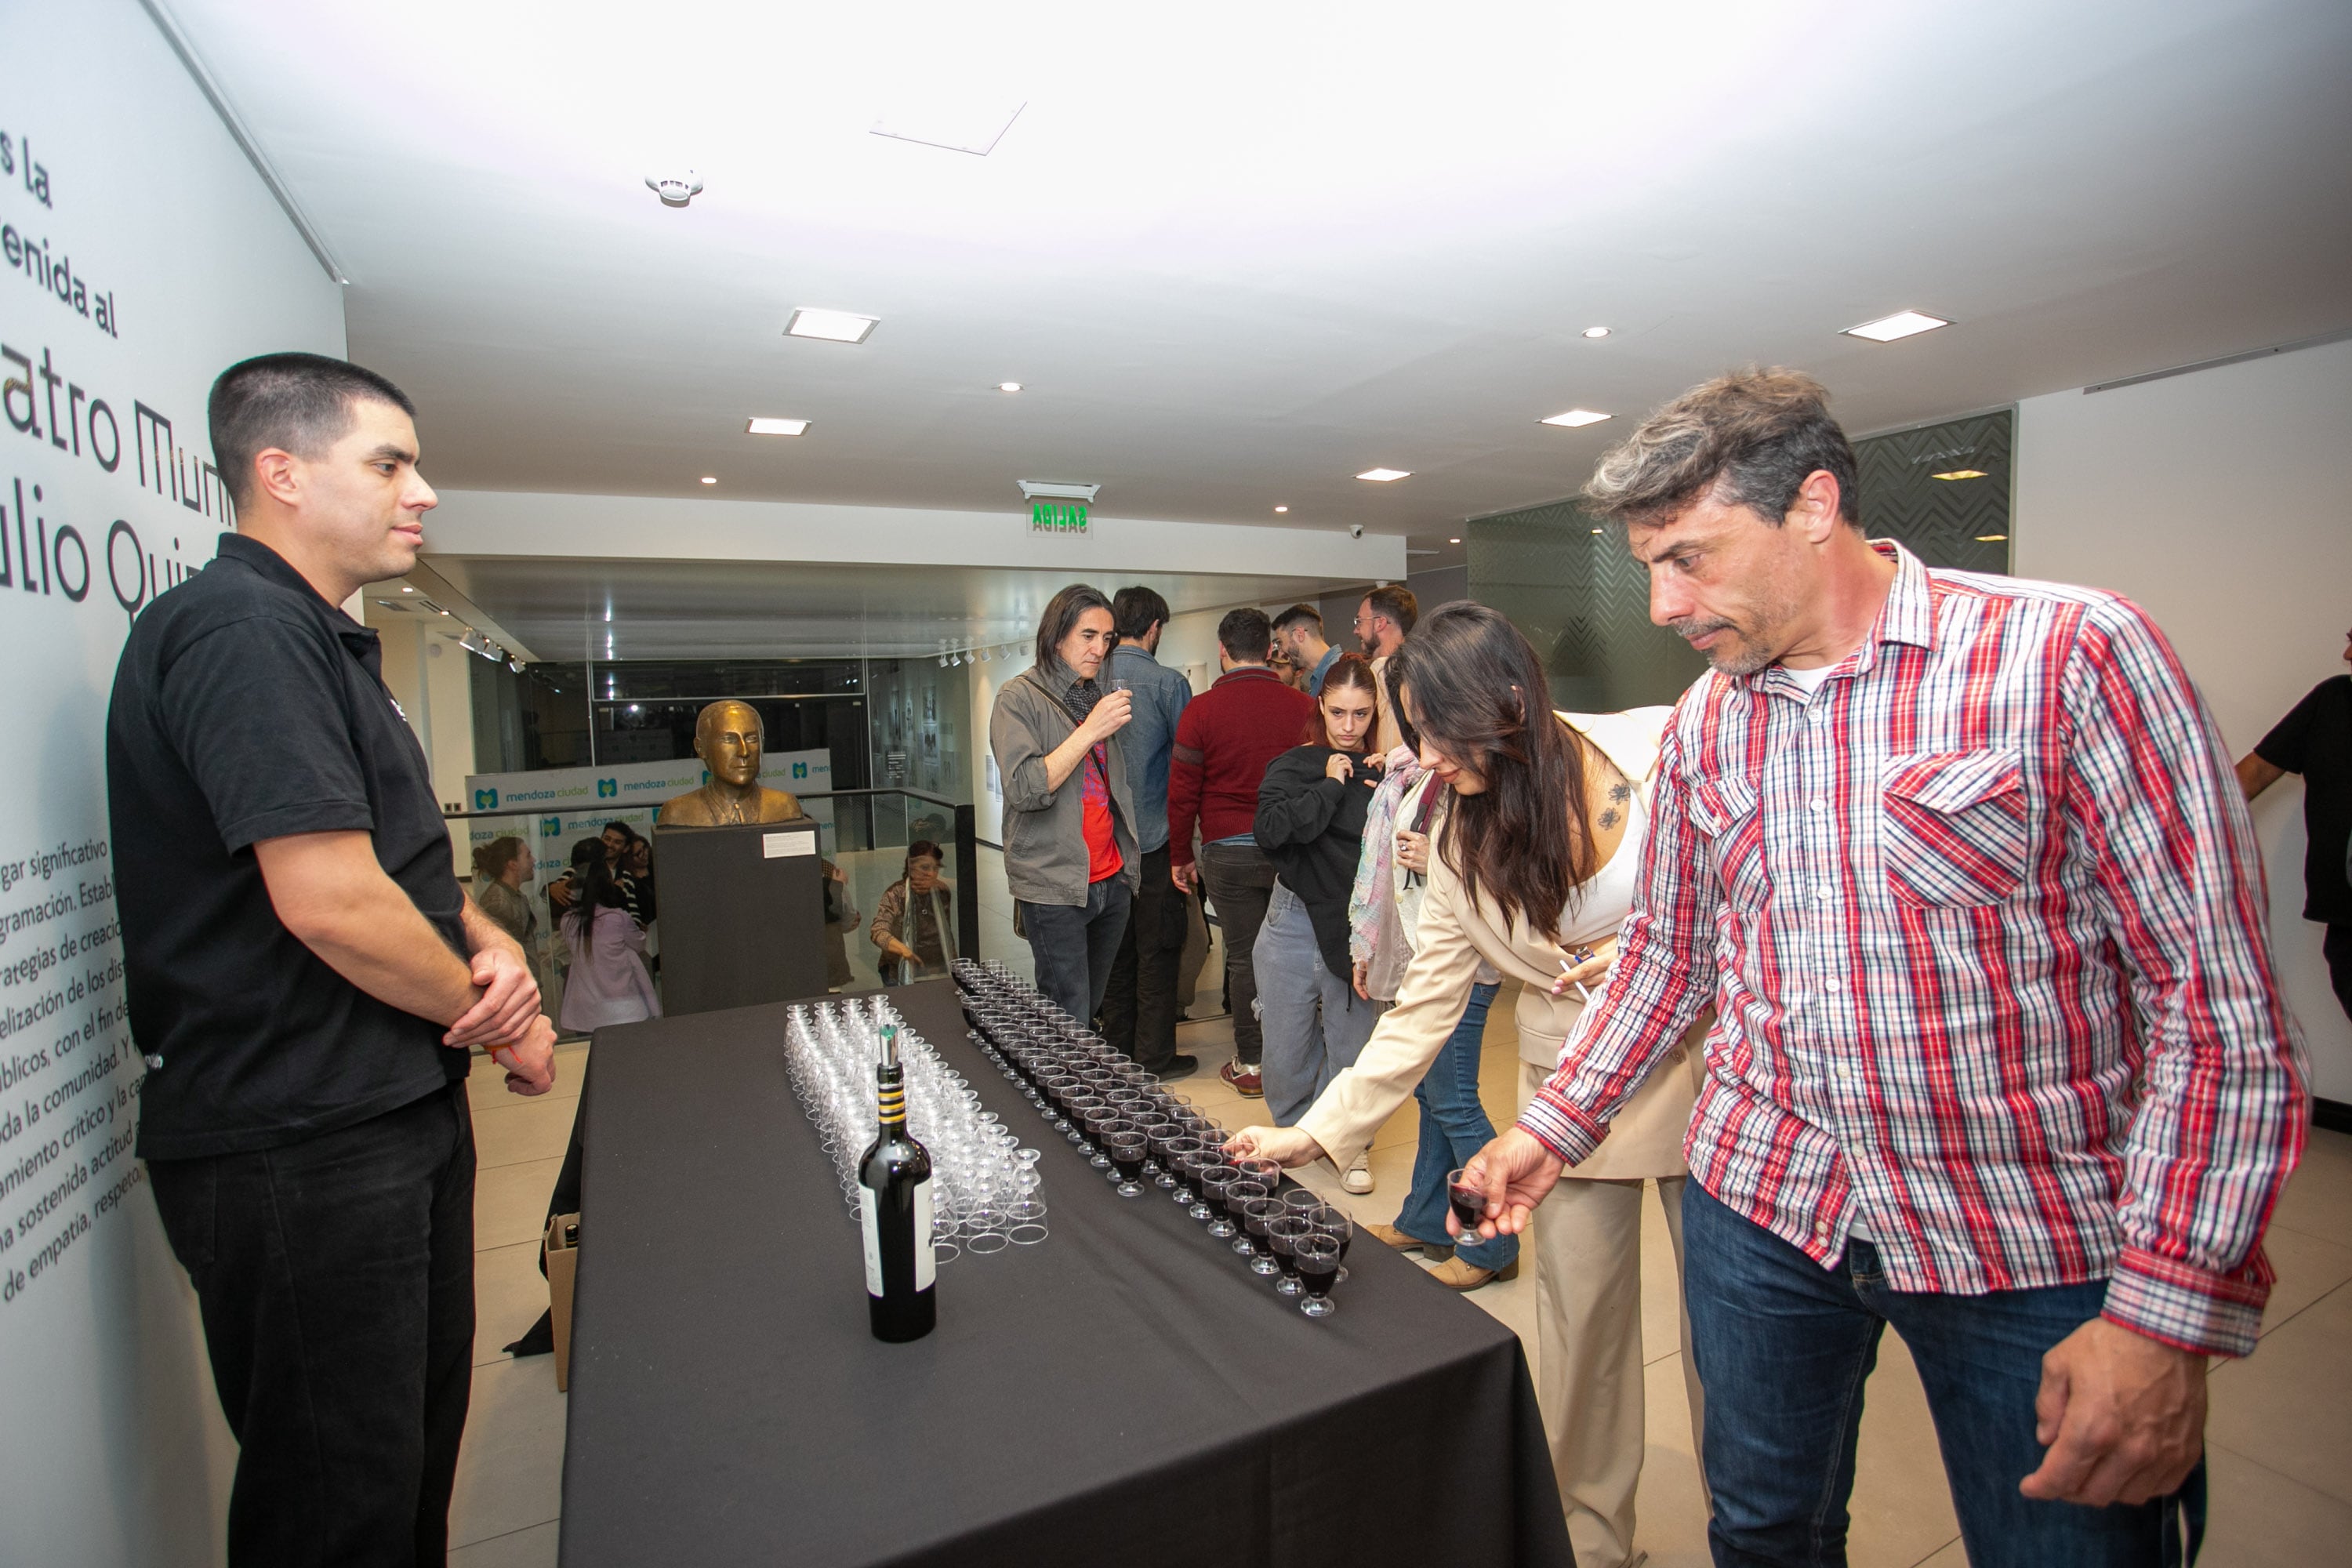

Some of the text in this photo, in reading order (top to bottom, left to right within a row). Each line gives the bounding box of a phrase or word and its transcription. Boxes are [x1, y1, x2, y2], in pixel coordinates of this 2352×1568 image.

[22, 136, 53, 210] la
[95, 289, 118, 339] al
[107, 518, 202, 626] Qui
[506, 786, 589, 803] mendoza ciudad
[624, 776, 694, 791] mendoza ciudad
[762, 768, 786, 779] ciudad
[30, 838, 107, 880] significativo
[60, 933, 77, 961] de
[67, 976, 84, 1004] de
[87, 969, 105, 994] los
[0, 1048, 50, 1092] blicos,
[55, 1029, 80, 1058] con
[83, 1012, 95, 1041] el
[98, 1007, 114, 1033] fin
[0, 1111, 23, 1144] da
[26, 1100, 40, 1127] la
[44, 1044, 120, 1113] comunidad.
[122, 1035, 129, 1059] Y
[107, 1098, 115, 1123] y
[116, 1085, 127, 1109] la
[18, 1163, 88, 1238] sostenida
[91, 1120, 133, 1175] actitud
[4, 1269, 26, 1303] de
[93, 1167, 142, 1219] respeto,
